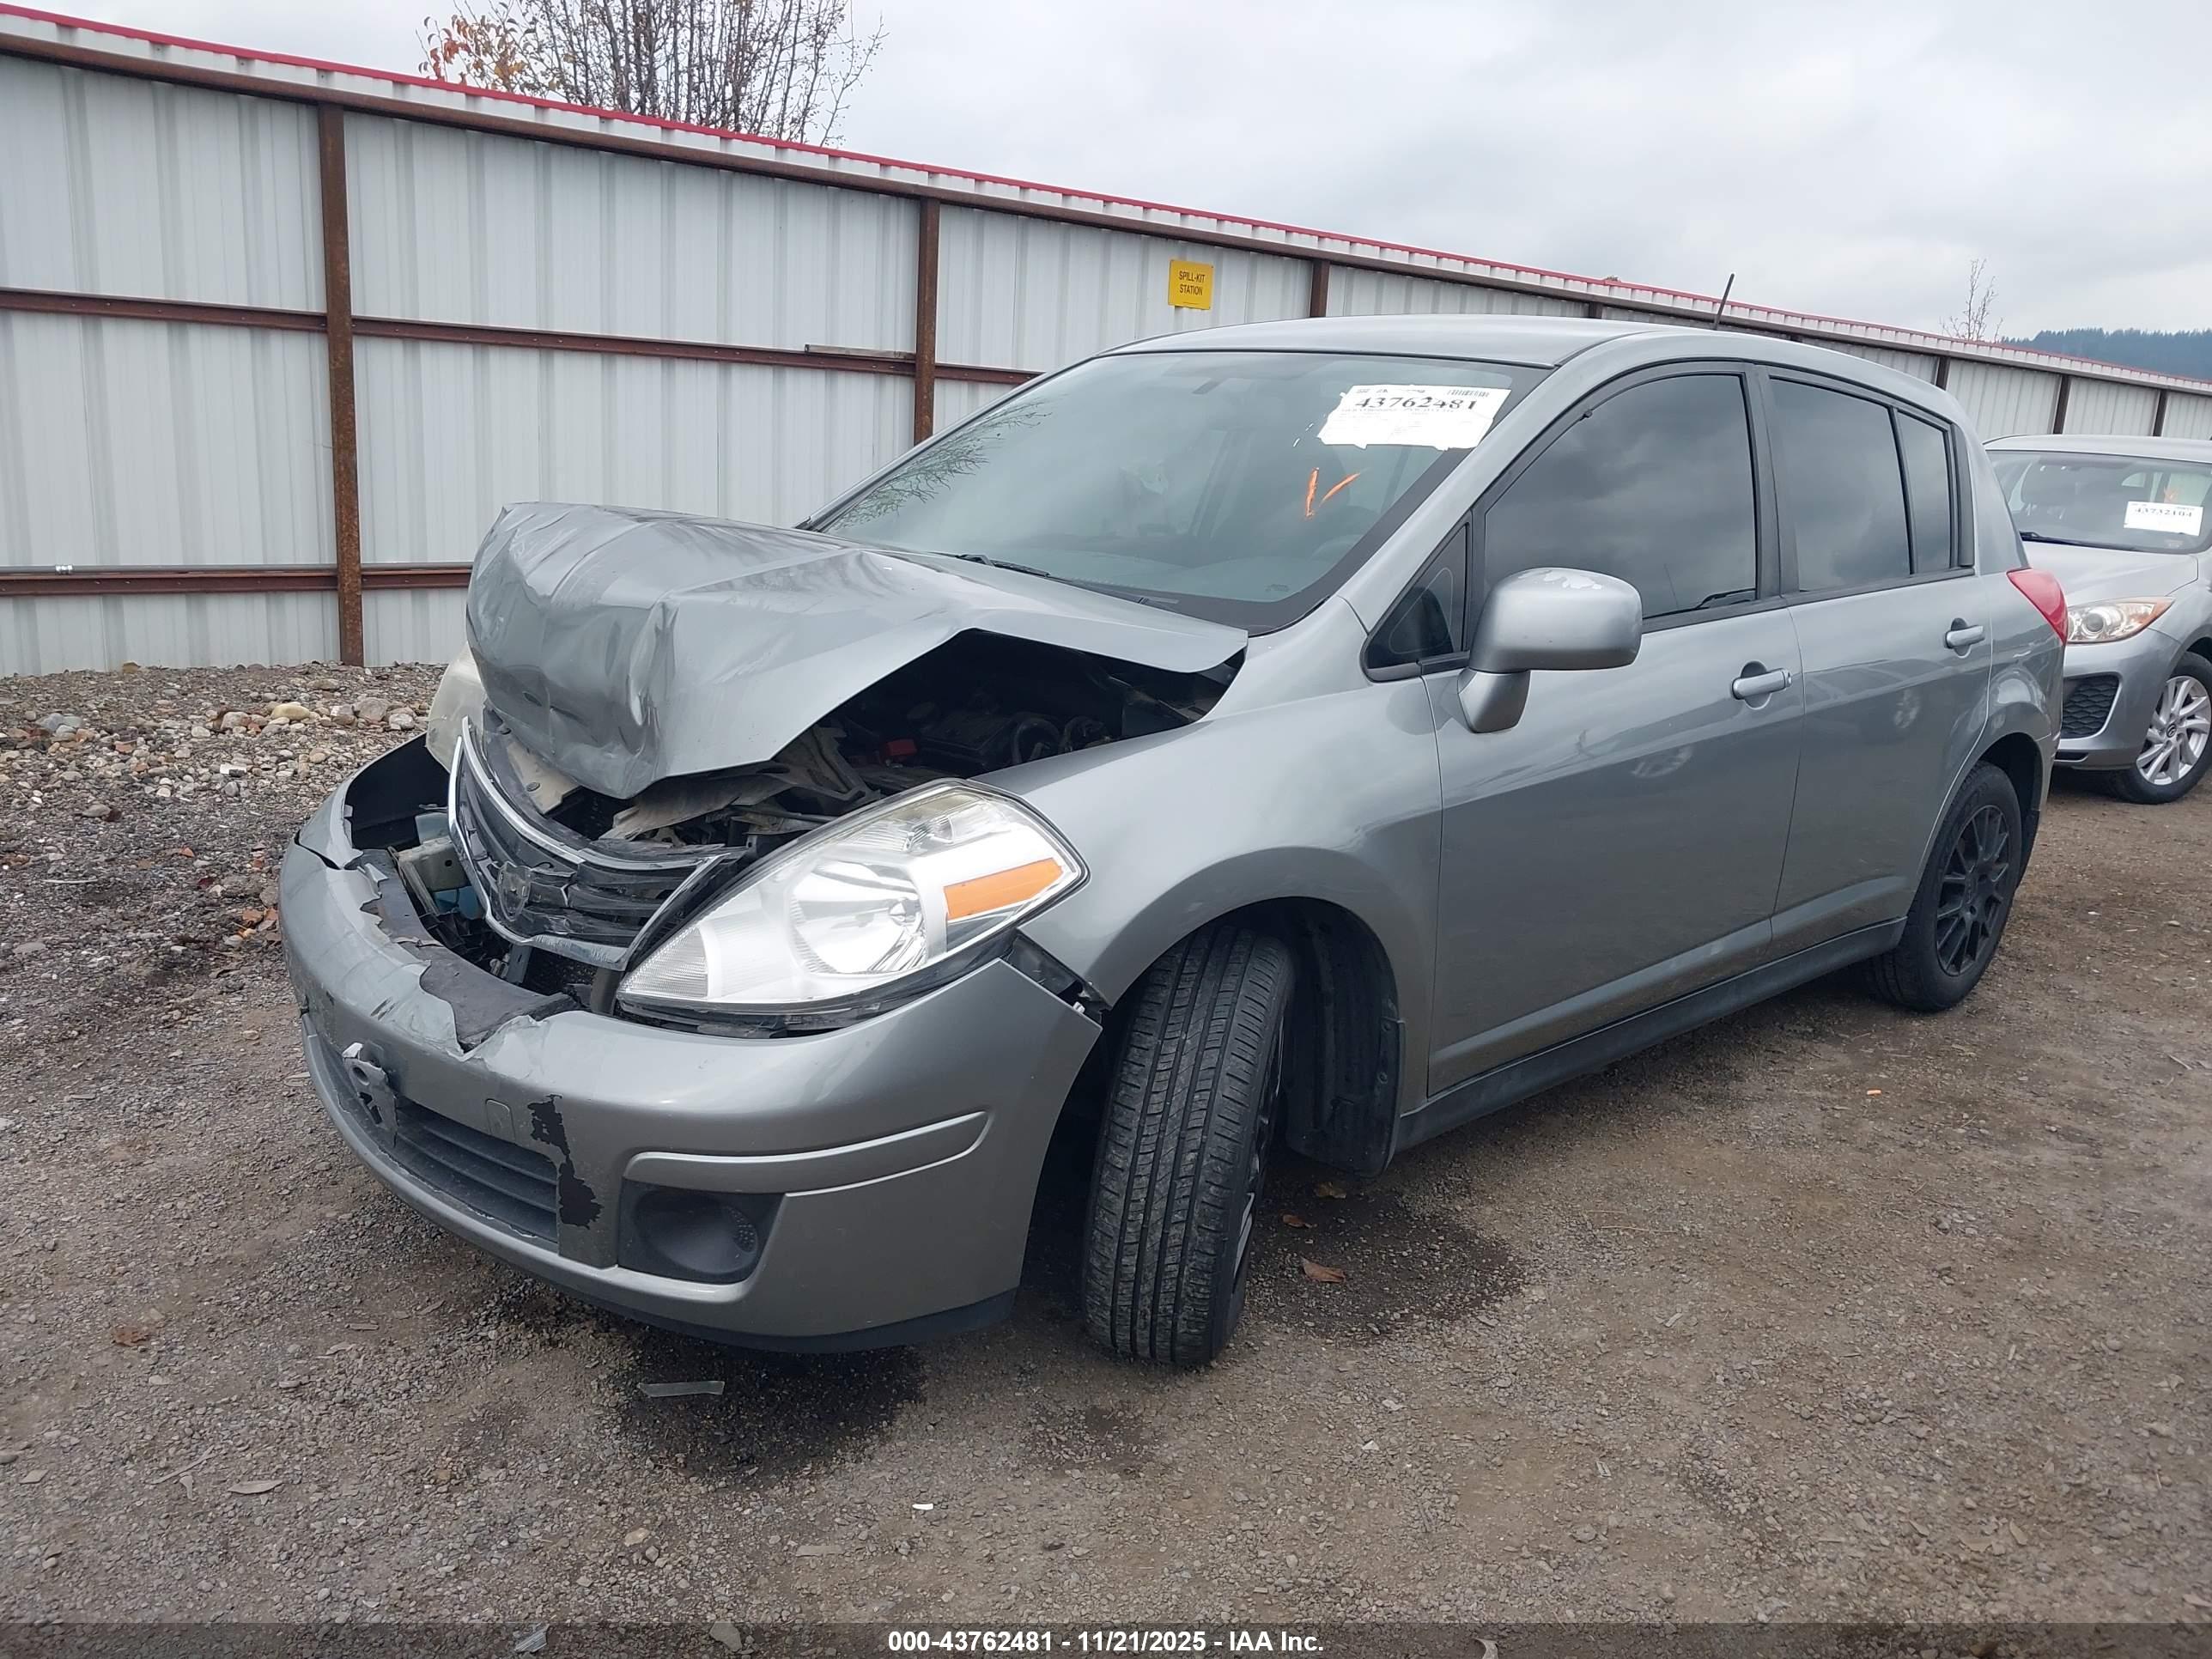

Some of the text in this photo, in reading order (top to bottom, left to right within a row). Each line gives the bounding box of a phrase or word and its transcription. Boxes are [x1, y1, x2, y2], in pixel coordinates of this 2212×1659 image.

[1178, 270, 1206, 283] SPILL-KIT
[1179, 284, 1203, 296] STATION
[1354, 396, 1478, 410] 43762481
